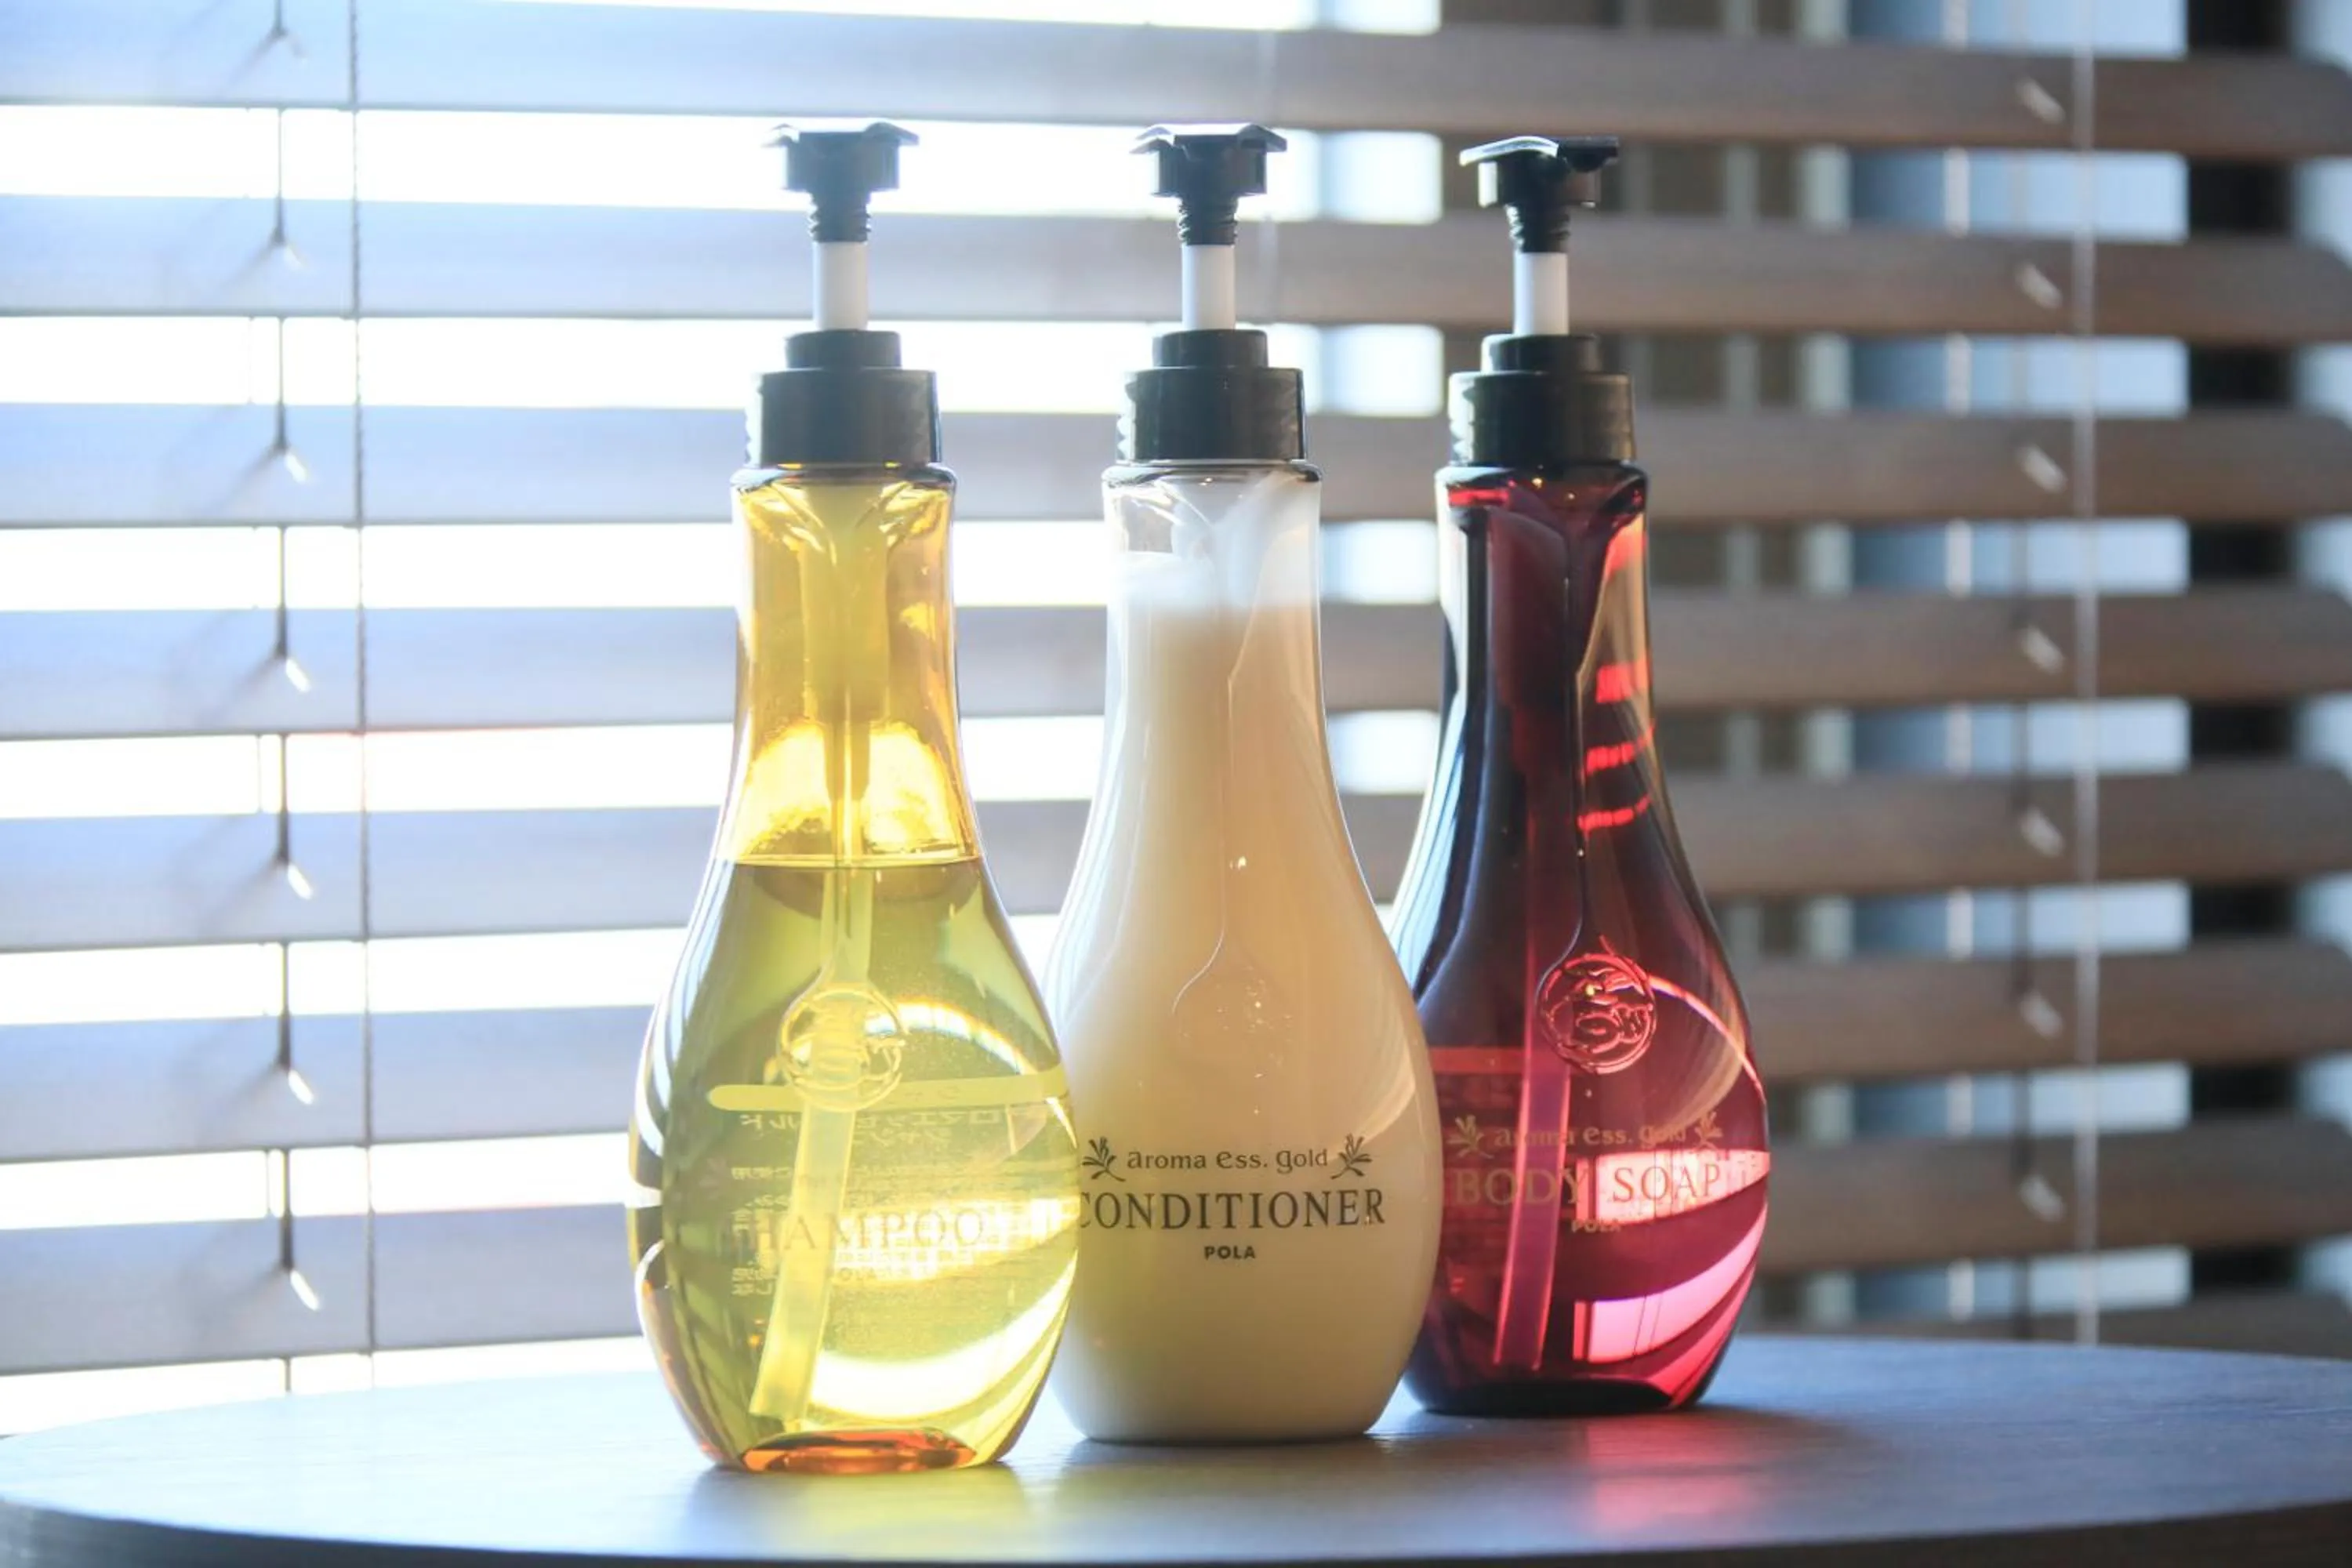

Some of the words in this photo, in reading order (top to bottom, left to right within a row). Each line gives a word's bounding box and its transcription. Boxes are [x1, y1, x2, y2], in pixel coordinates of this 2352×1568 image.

[1582, 1124, 1633, 1145] ess.
[1127, 1151, 1207, 1170] aroma
[1215, 1150, 1269, 1169] ess.
[1276, 1149, 1328, 1174] gold
[1454, 1167, 1590, 1207] BODY
[1611, 1163, 1720, 1203] SOAP
[1571, 1218, 1621, 1233] POLA
[1203, 1245, 1257, 1260] POLA
